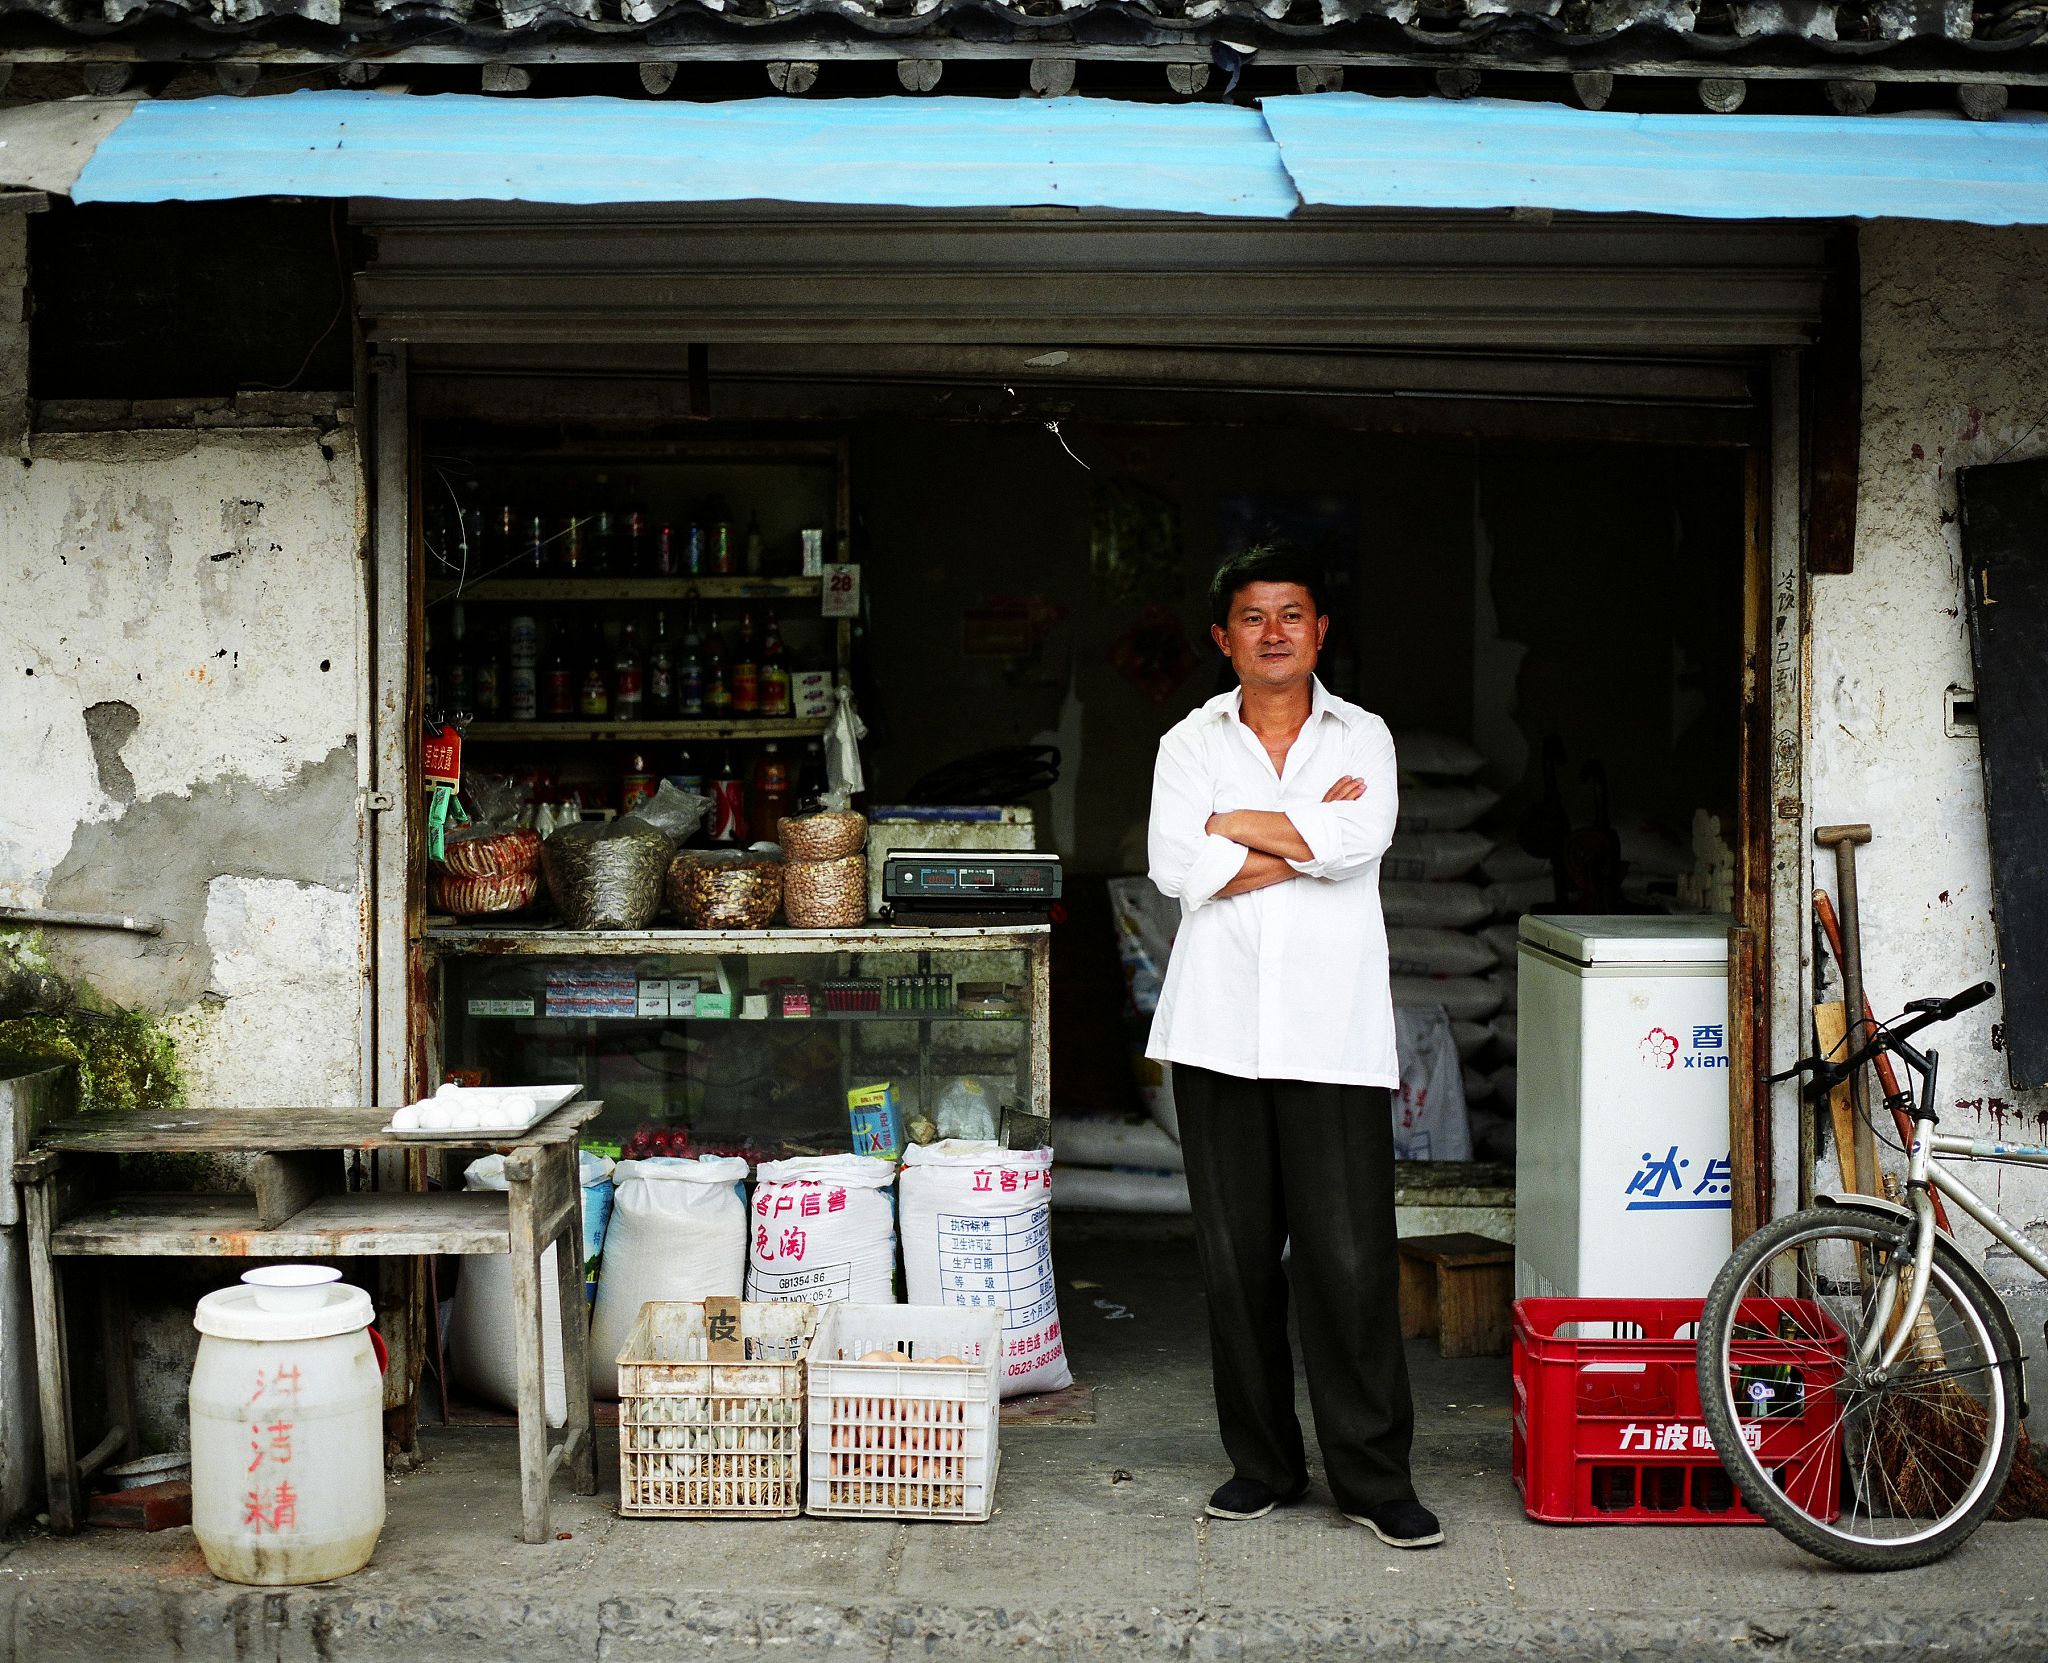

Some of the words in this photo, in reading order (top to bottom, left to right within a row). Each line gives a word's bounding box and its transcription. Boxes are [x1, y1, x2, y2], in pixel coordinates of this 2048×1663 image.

[830, 575, 851, 592] 28
[1692, 1023, 1723, 1049] 香
[756, 1185, 847, 1219] 客户信誉
[755, 1223, 807, 1262] 免淘
[951, 1237, 993, 1252] 卫生许可证
[952, 1256, 994, 1270] 生产日期
[778, 1272, 826, 1289] GB1354-86
[707, 1308, 740, 1344] 皮
